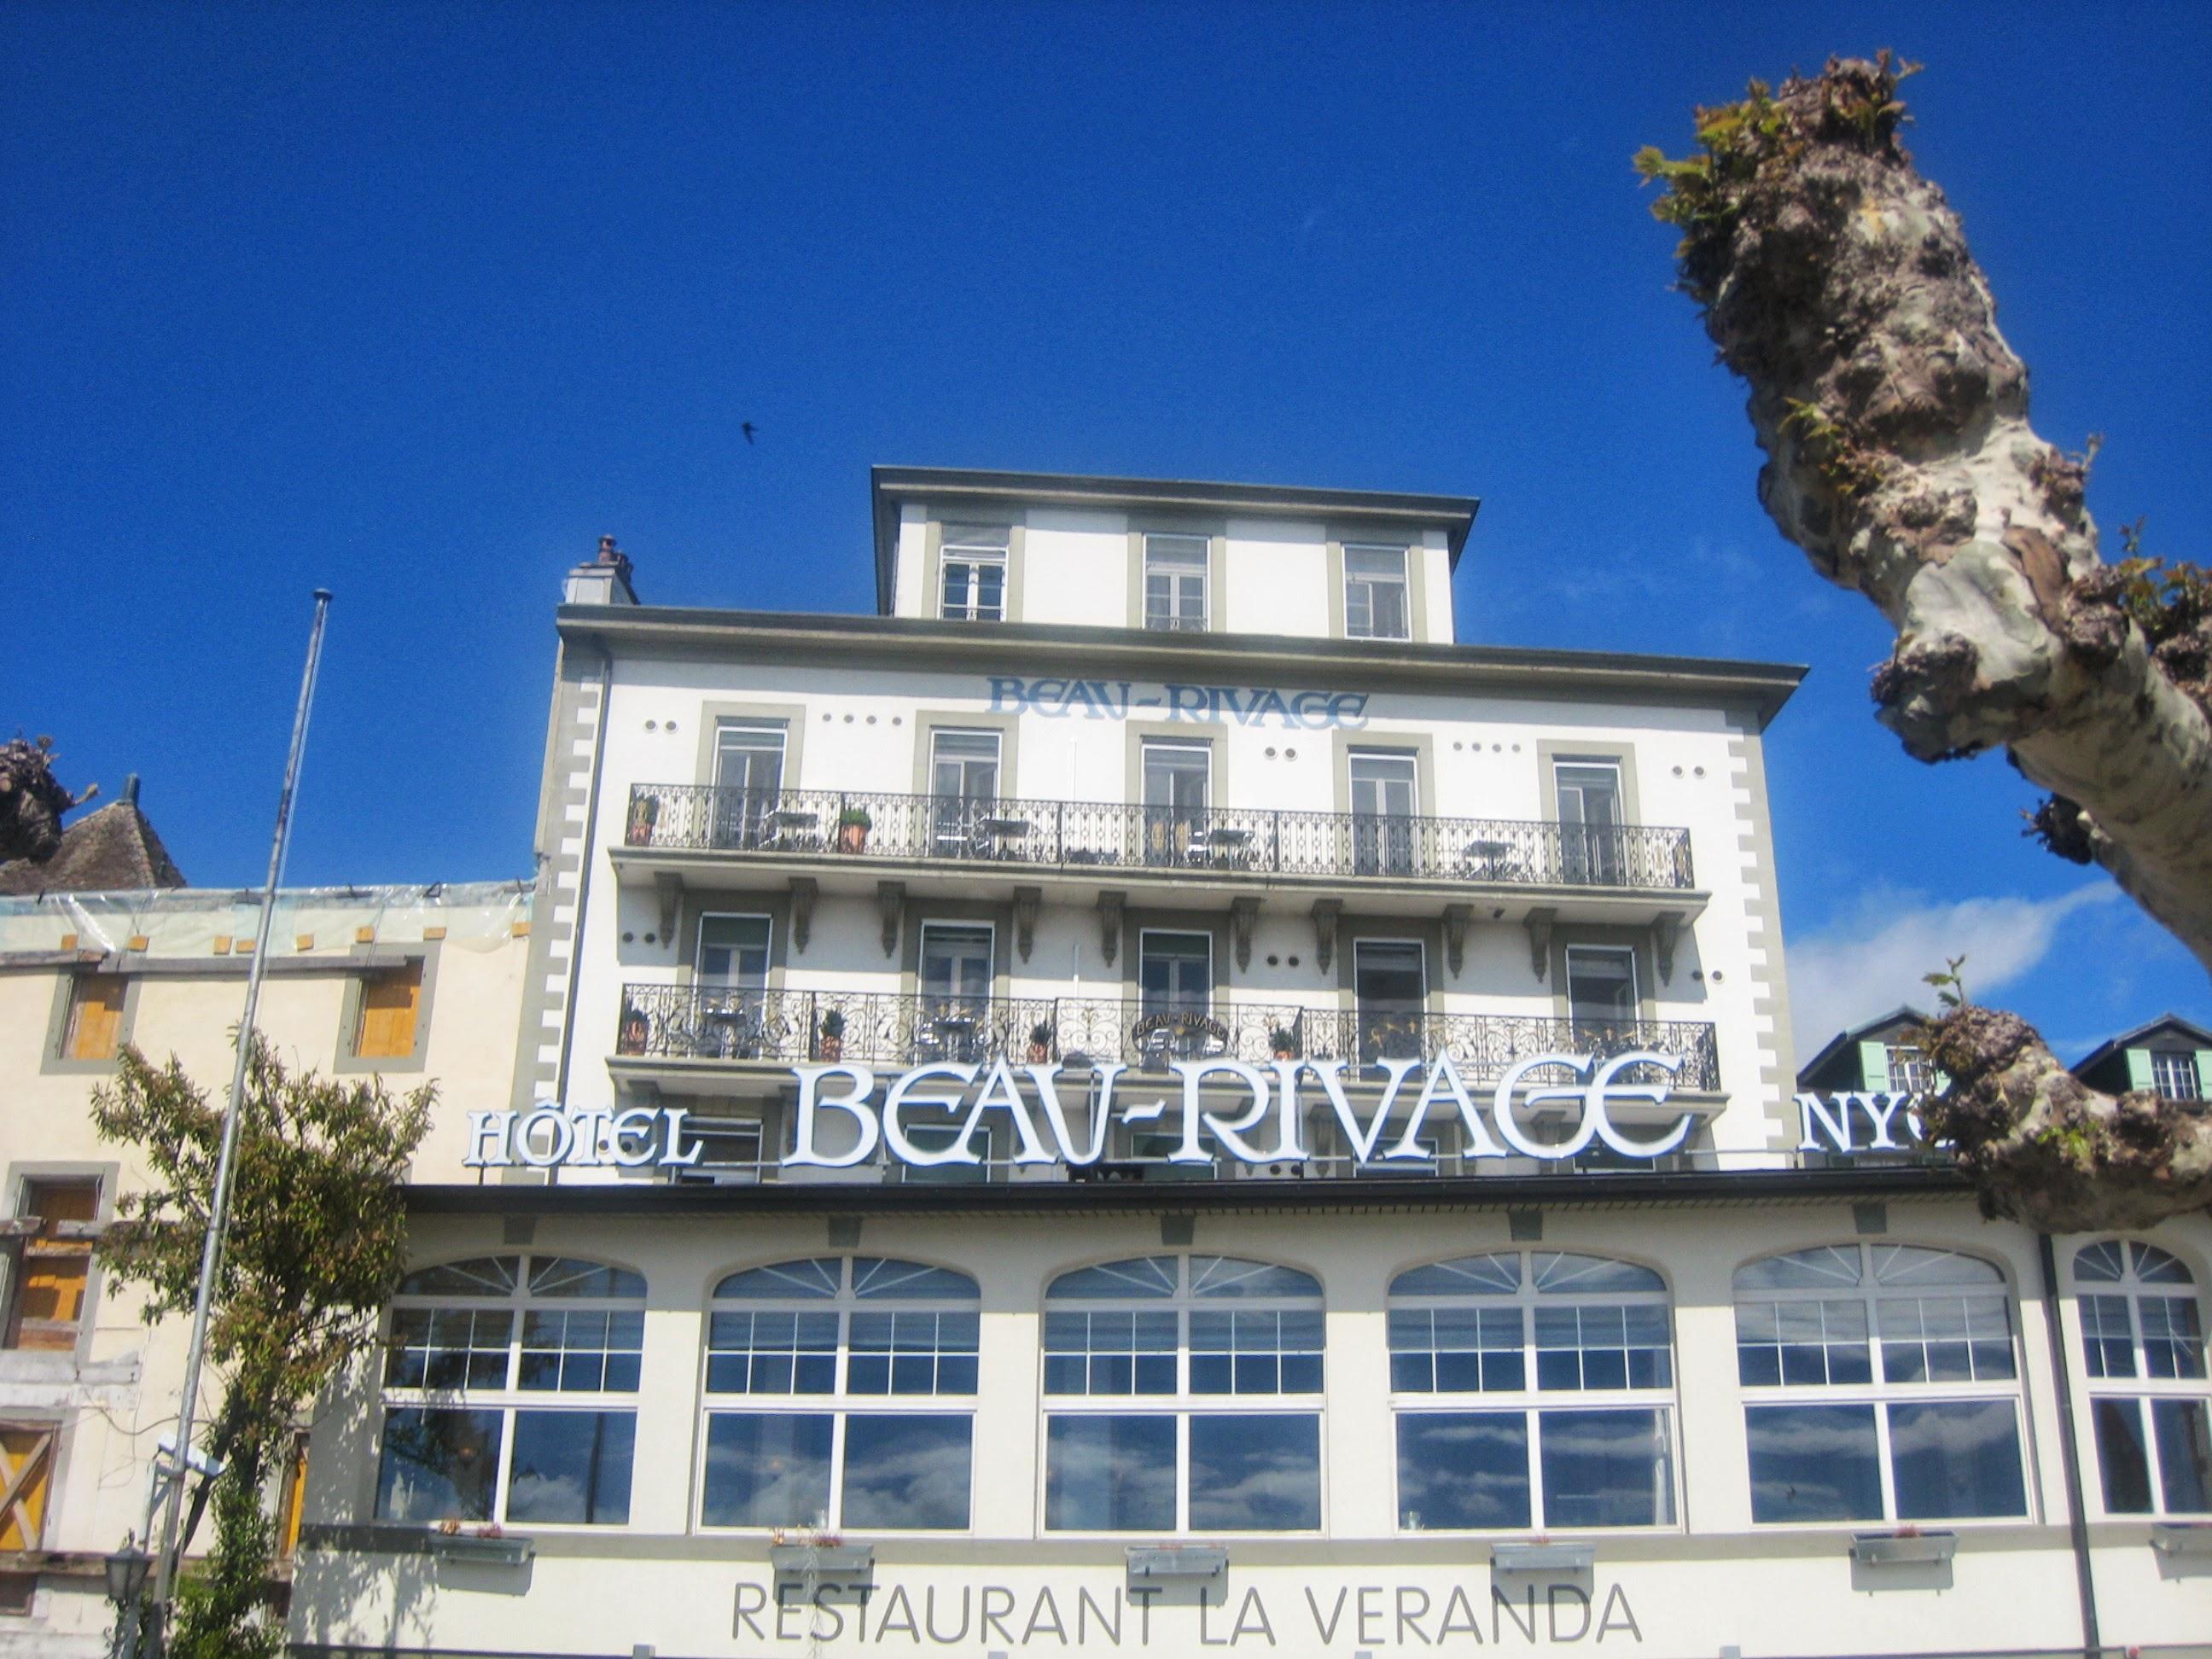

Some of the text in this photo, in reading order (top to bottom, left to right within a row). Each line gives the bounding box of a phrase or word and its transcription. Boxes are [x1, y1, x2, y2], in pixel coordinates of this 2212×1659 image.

[987, 677, 1370, 731] BEAU-RIVAGE
[462, 1100, 704, 1167] HÔTEL
[780, 1049, 1694, 1167] BEAU-RIVAGE
[731, 1582, 1643, 1645] RESTAURANT LA VERANDA
